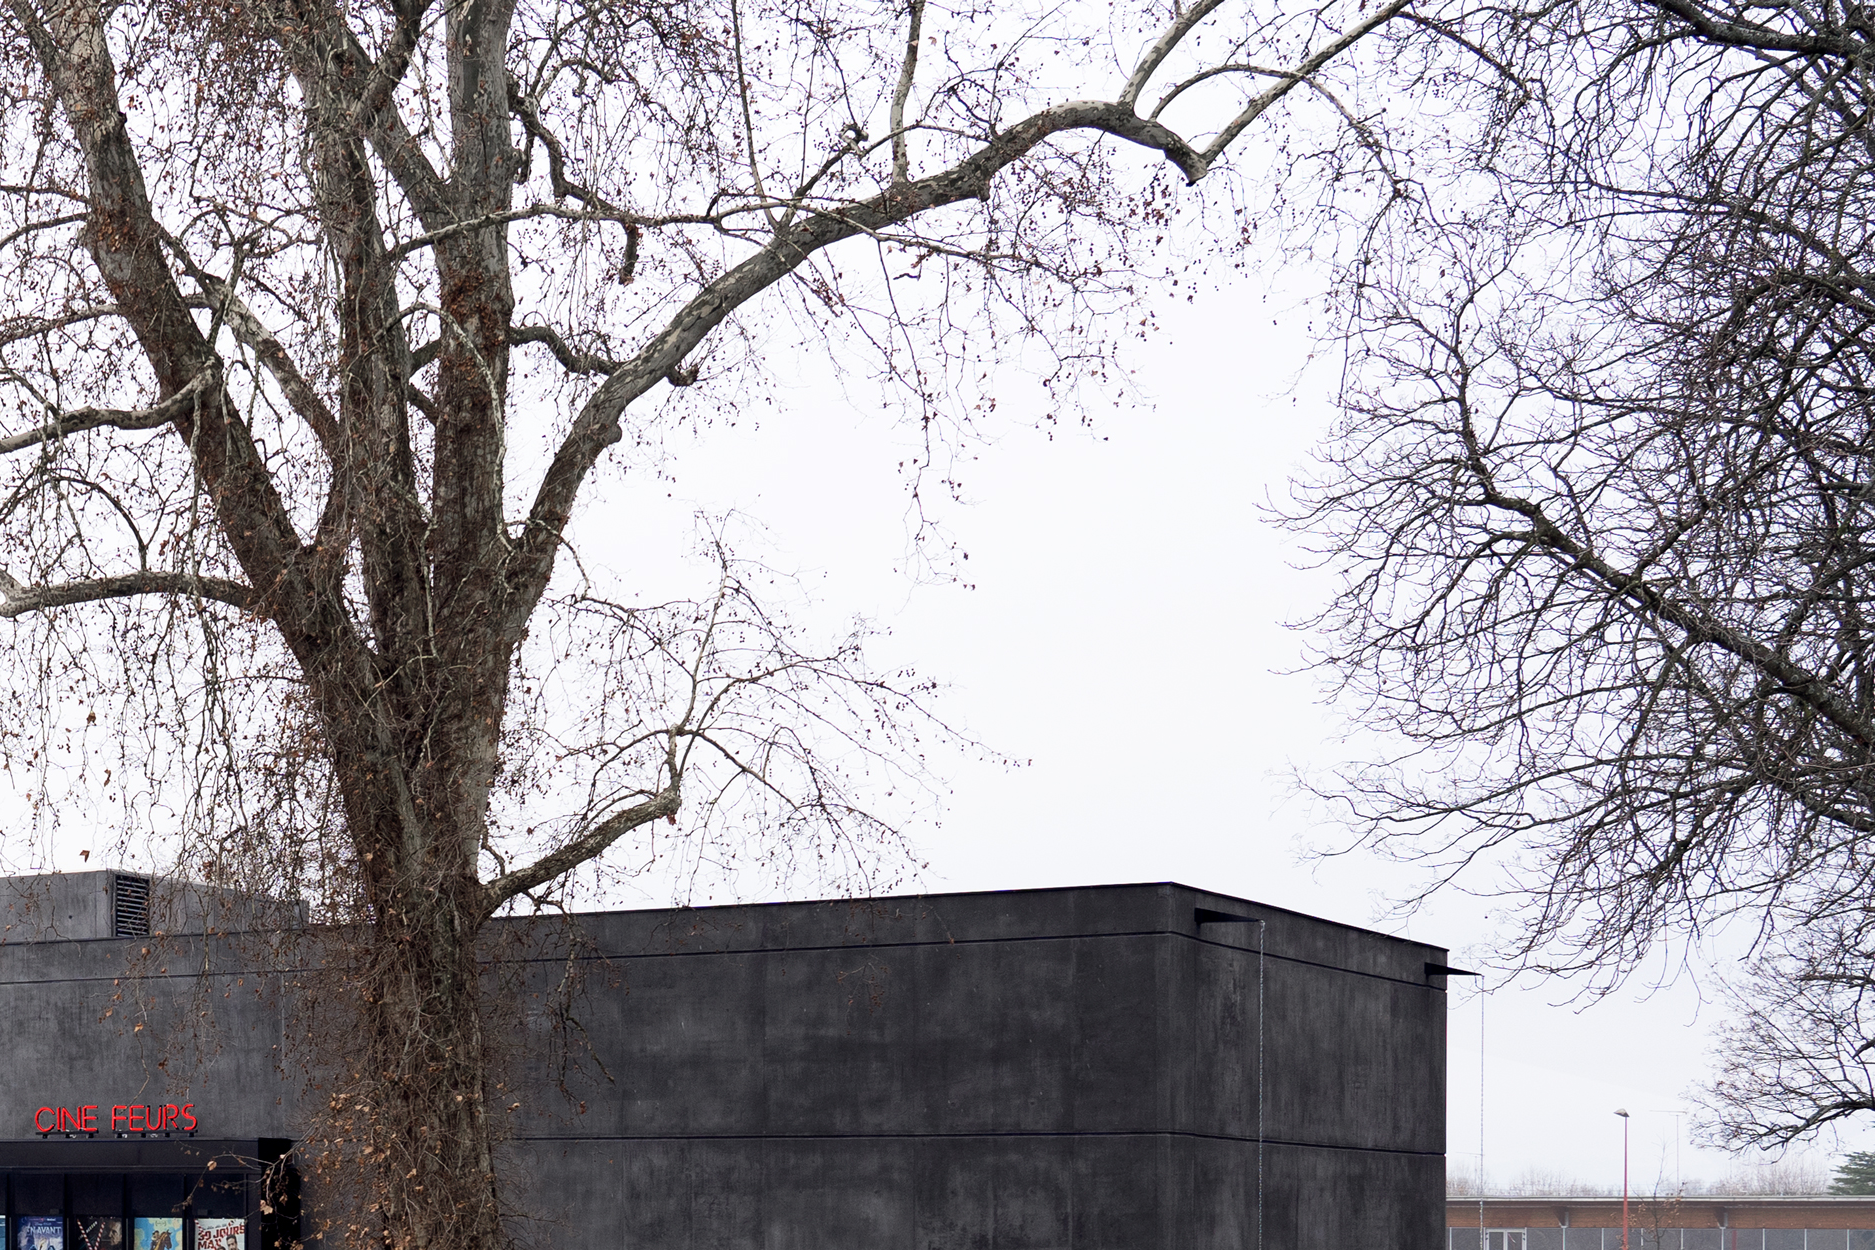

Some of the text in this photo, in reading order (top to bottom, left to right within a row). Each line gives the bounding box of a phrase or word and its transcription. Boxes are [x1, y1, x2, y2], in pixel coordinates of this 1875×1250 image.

[35, 1104, 197, 1132] CINE FEURS
[37, 1226, 61, 1234] AVANT
[213, 1224, 245, 1238] JOURS
